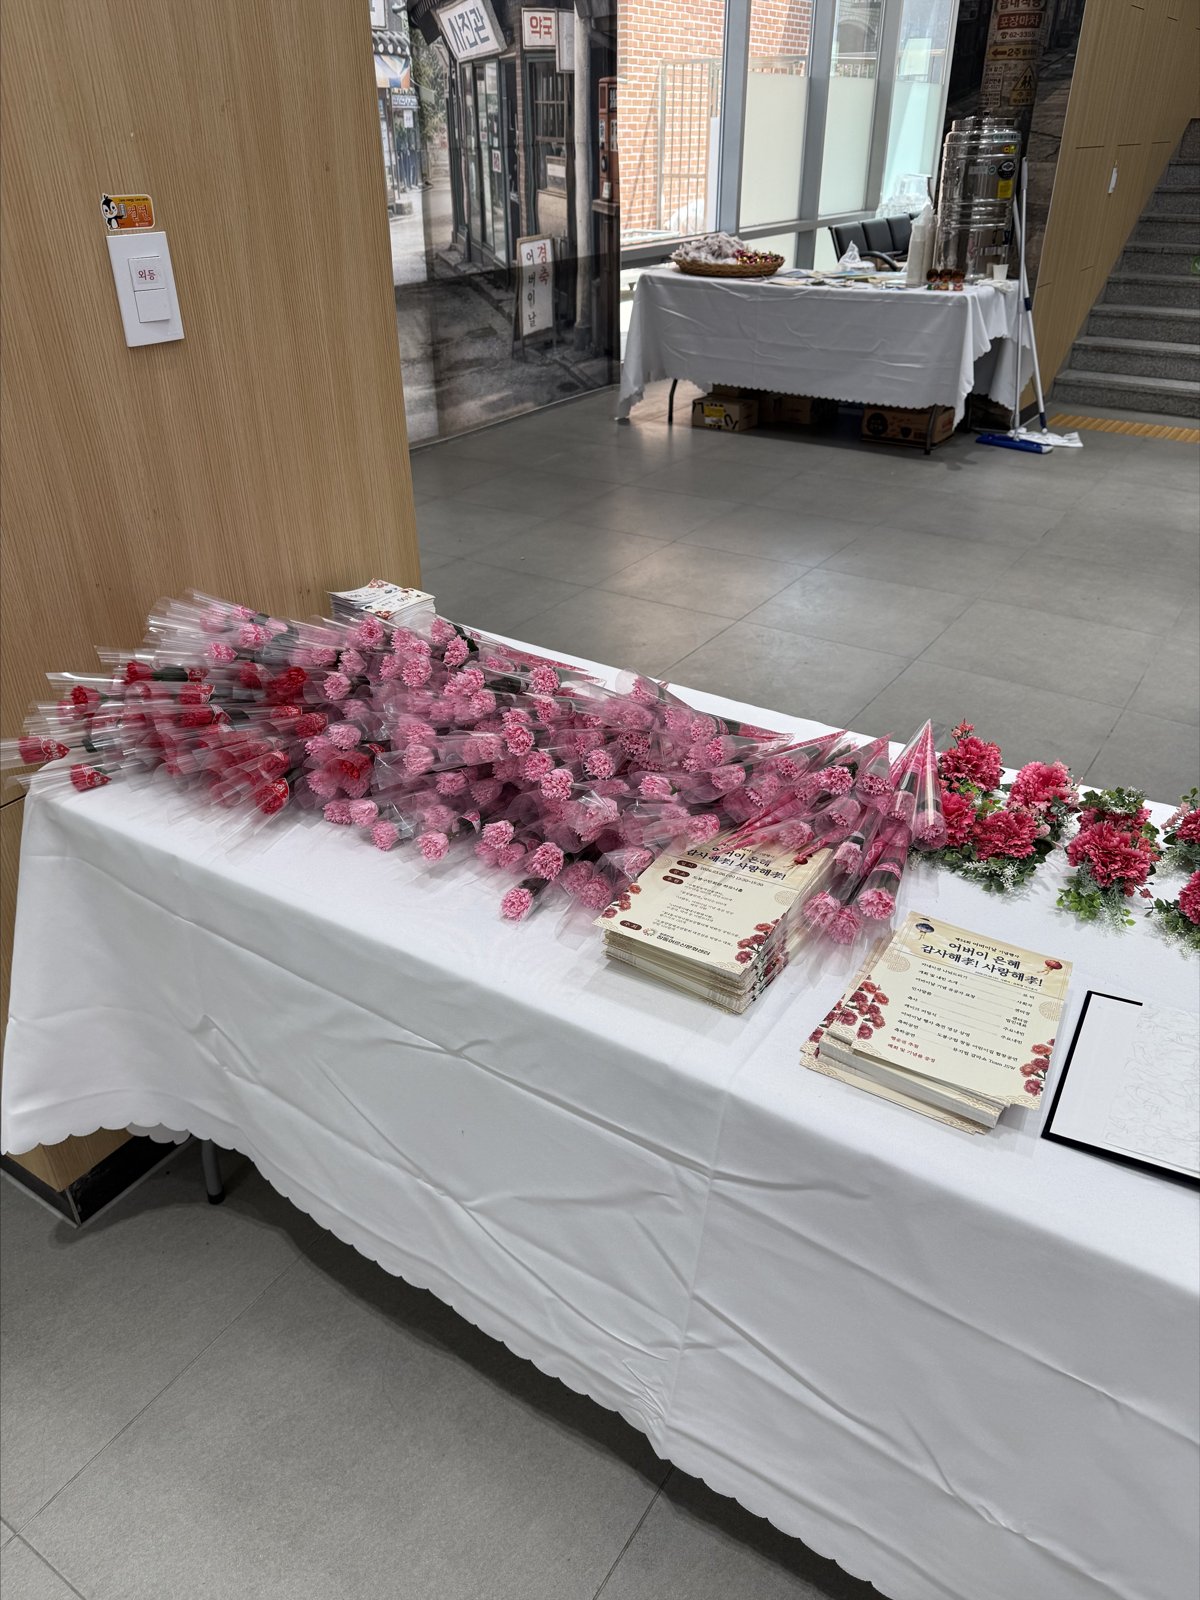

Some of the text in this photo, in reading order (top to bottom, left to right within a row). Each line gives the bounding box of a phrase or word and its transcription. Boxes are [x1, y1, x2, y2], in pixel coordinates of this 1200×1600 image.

[448, 7, 490, 53] 사진관
[529, 15, 553, 39] 약국
[1000, 14, 1040, 27] 포장마차
[923, 945, 978, 967] 감사해孝!
[983, 964, 1042, 986] 사랑해孝!
[949, 943, 1020, 969] 어버이 은혜
